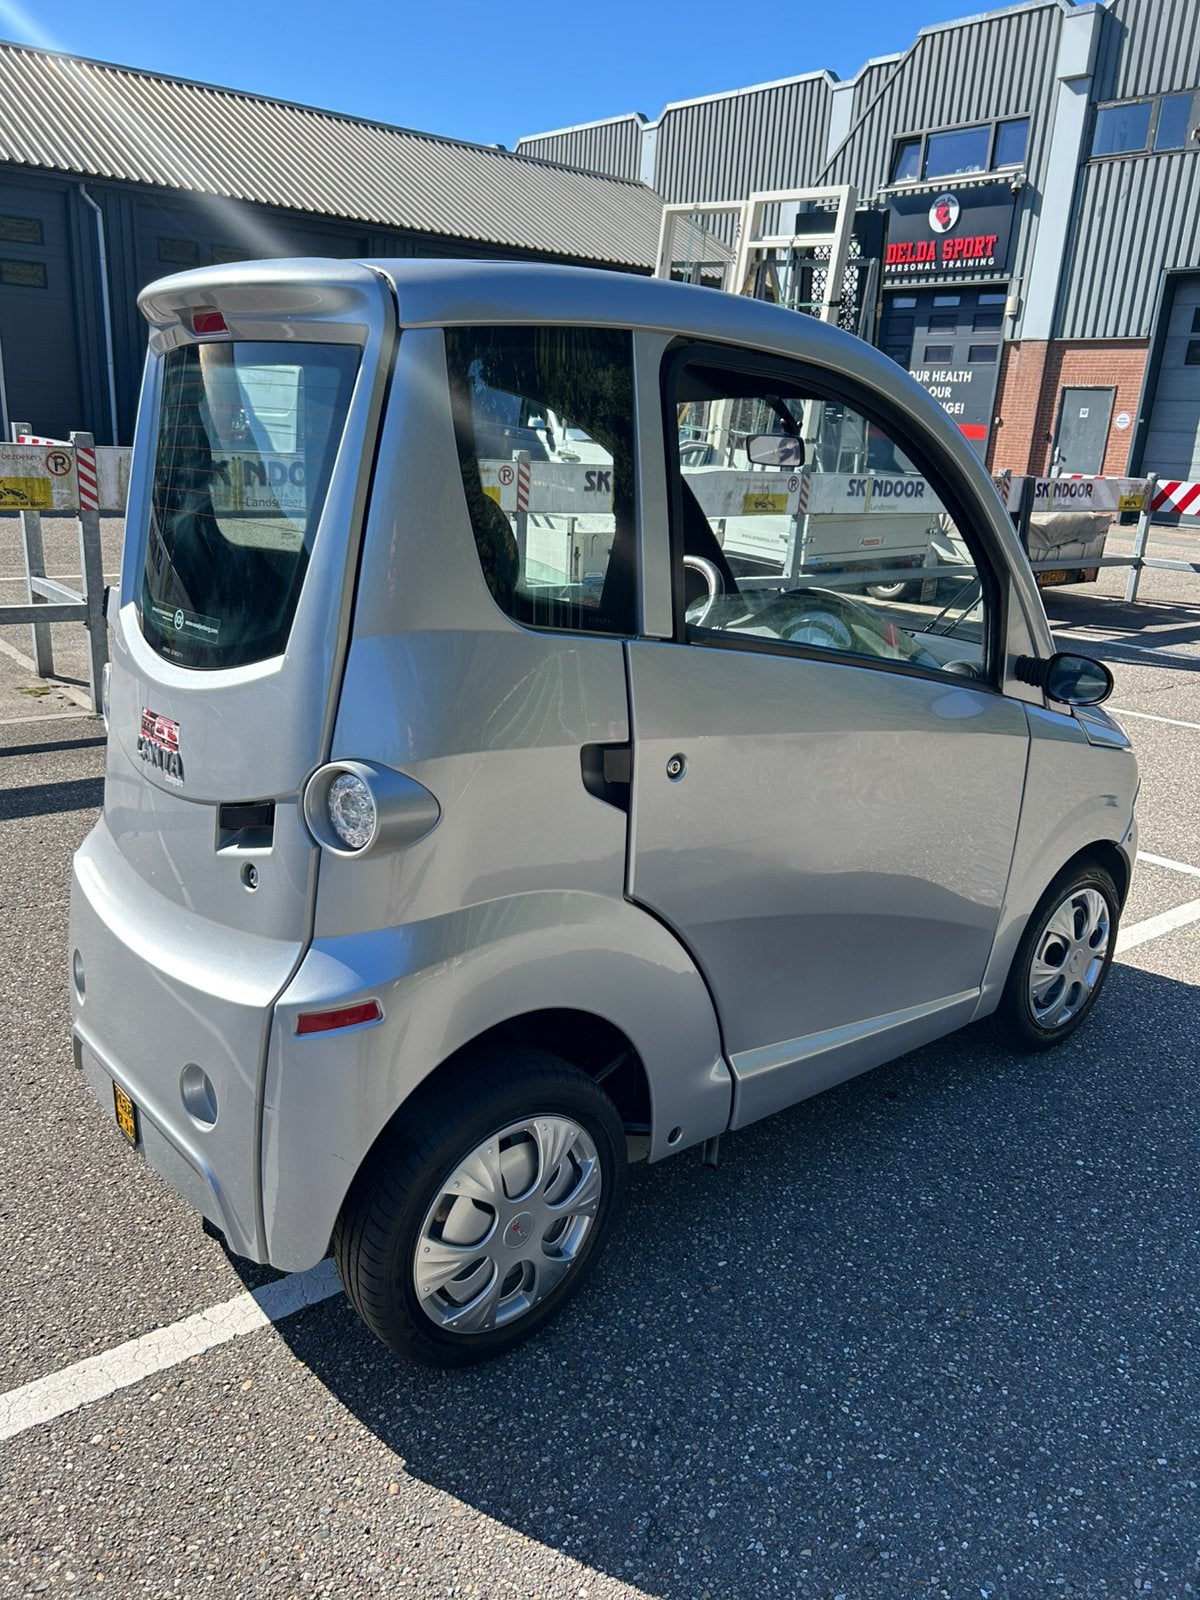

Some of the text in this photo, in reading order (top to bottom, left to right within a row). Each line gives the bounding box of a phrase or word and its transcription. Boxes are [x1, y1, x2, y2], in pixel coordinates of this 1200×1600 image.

[885, 234, 998, 264] DELDA SPORT
[884, 257, 995, 272] PERSONAL TRAINING
[931, 370, 972, 383] HEALTH
